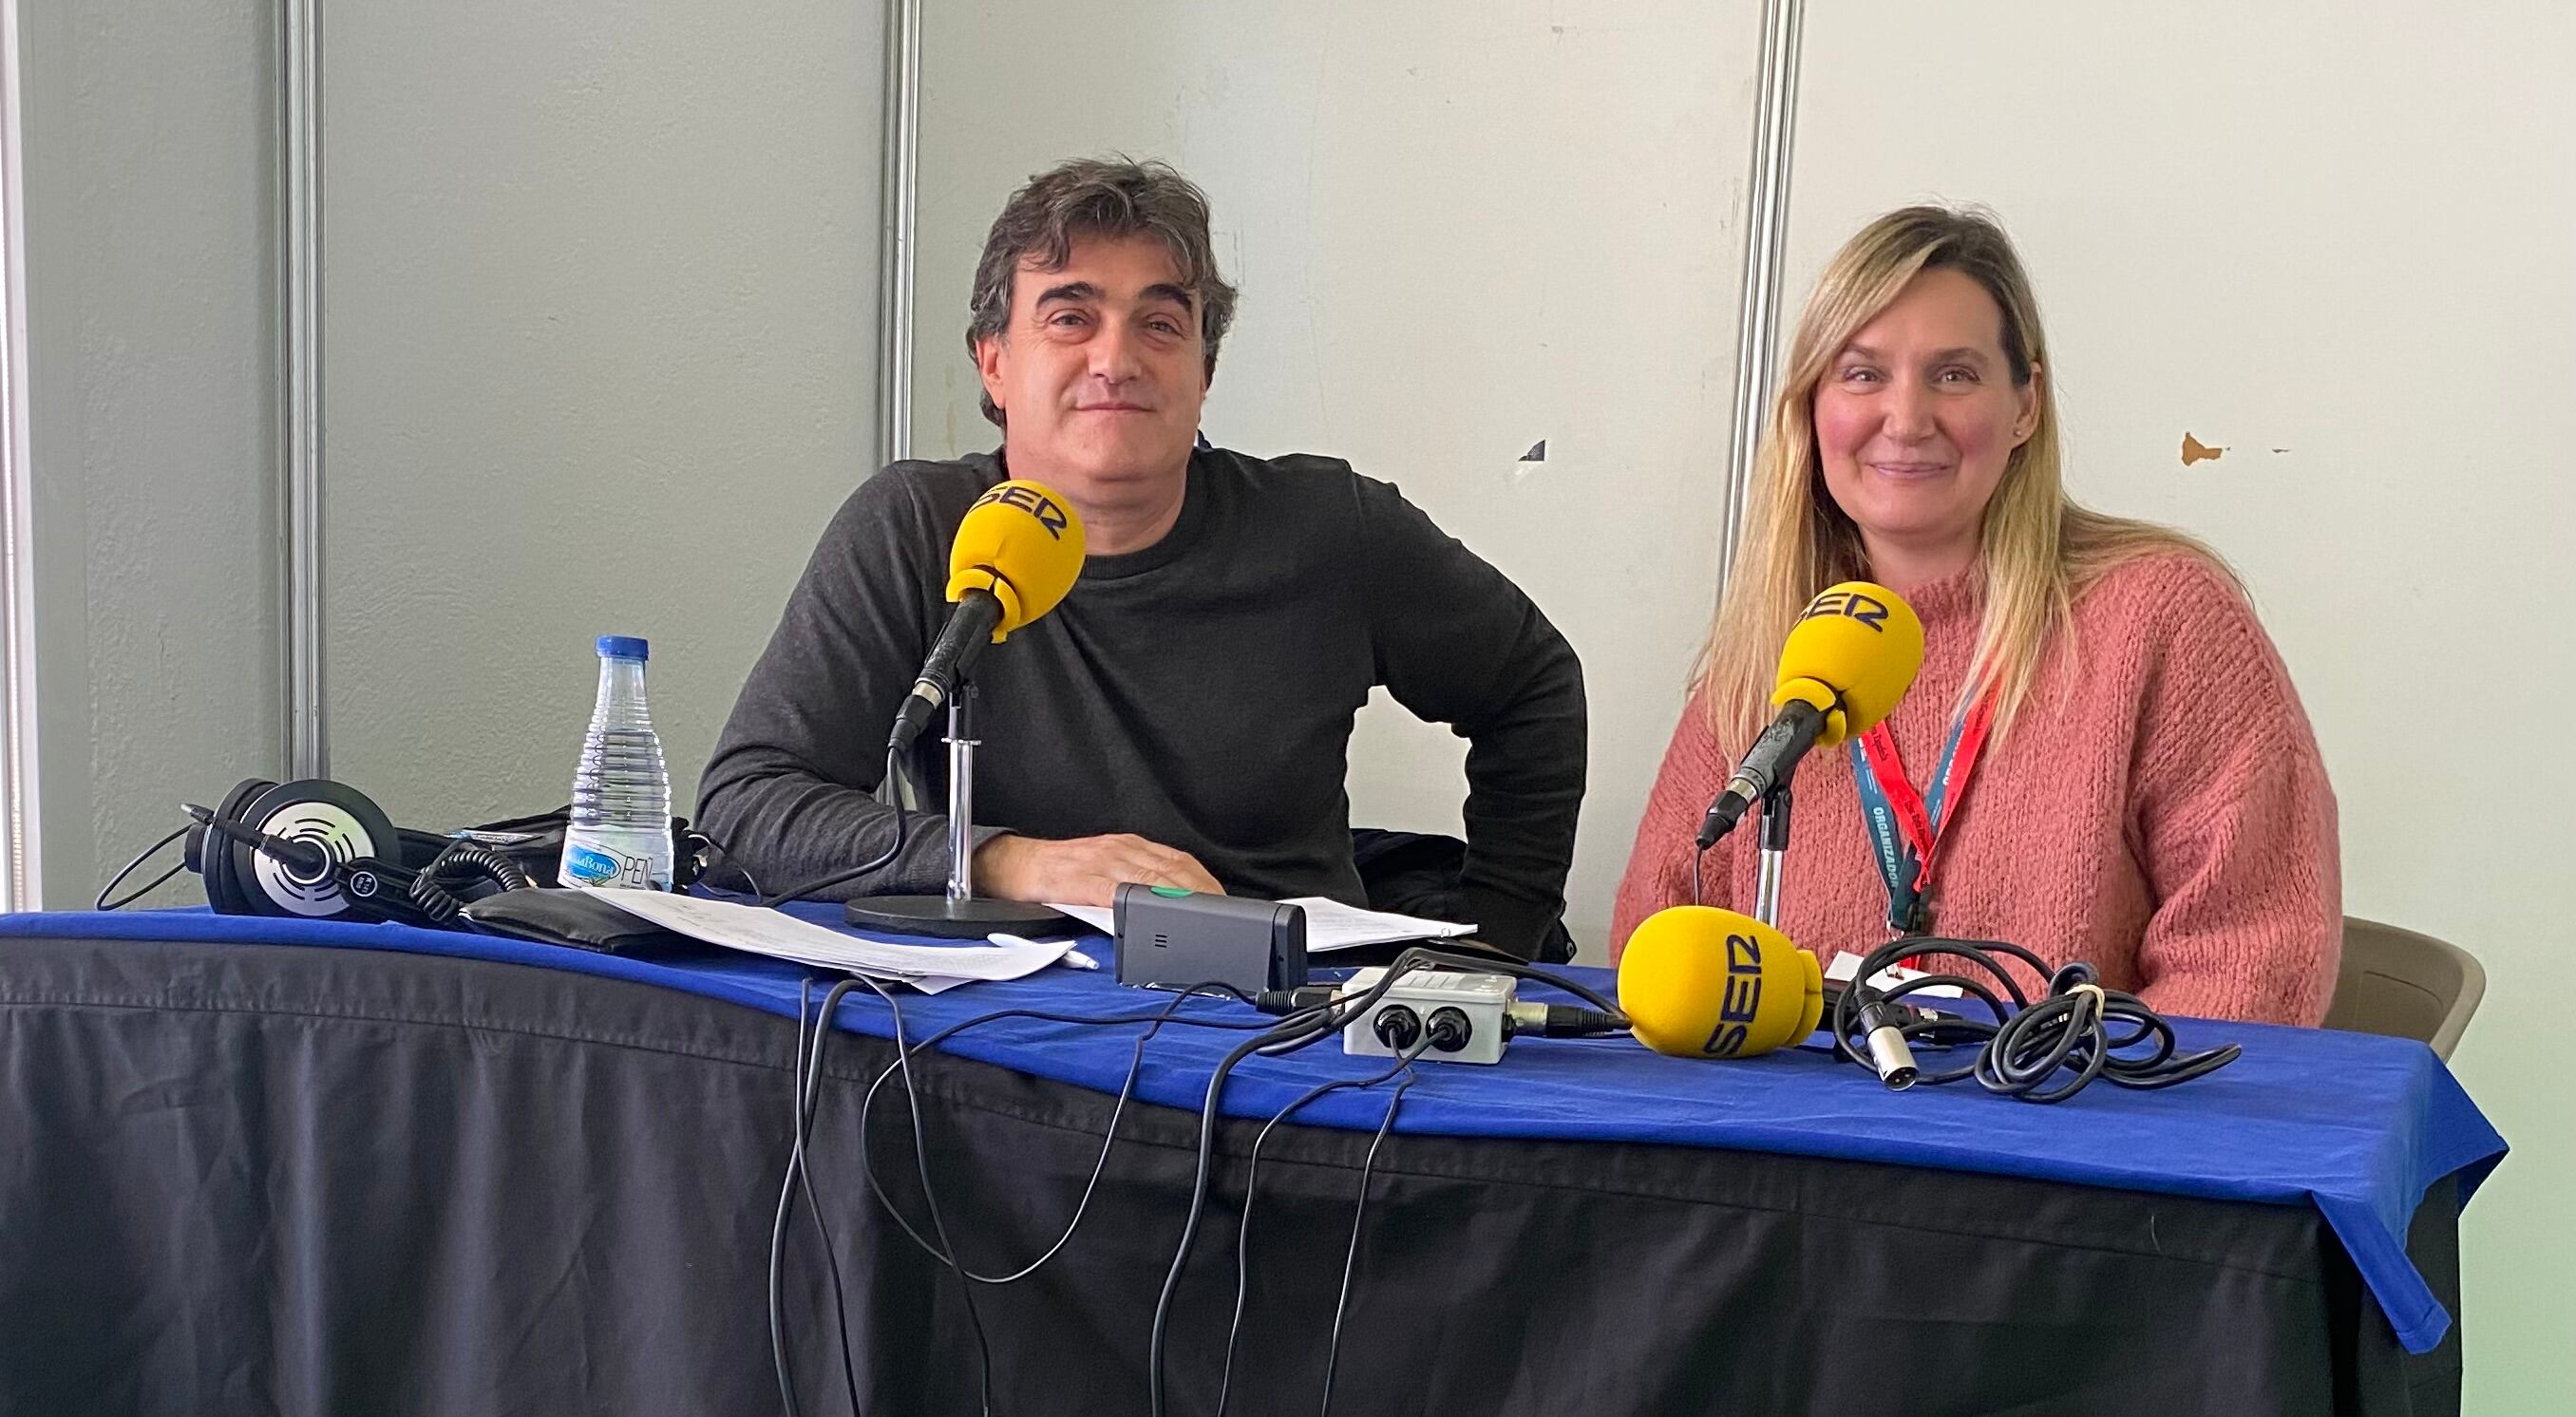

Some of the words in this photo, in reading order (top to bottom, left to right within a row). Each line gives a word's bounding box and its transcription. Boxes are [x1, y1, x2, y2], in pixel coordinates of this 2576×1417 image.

[968, 485, 1068, 540] SER
[1872, 806, 1901, 888] ORGANIZADOR
[1702, 934, 1762, 1055] SER
